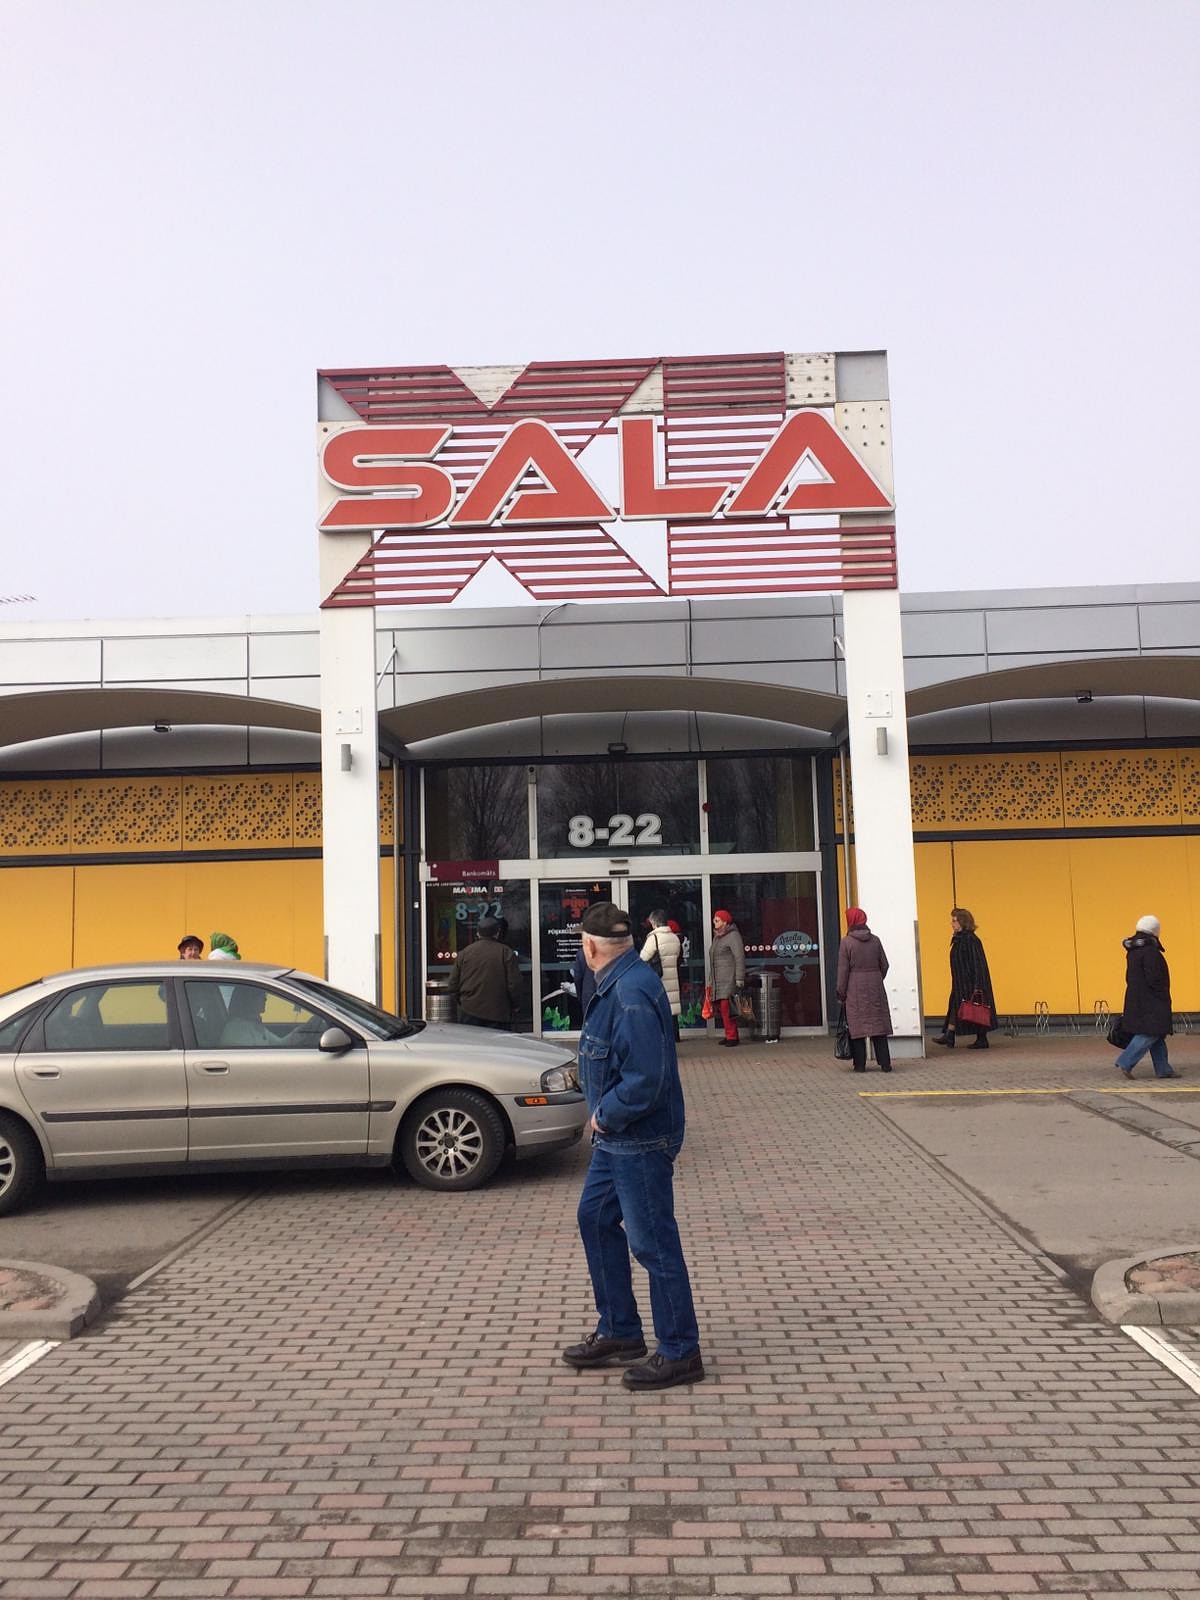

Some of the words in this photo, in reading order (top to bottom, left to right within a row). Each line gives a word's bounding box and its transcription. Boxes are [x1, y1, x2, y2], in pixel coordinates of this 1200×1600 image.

[318, 410, 895, 531] SALA
[568, 815, 663, 847] 8-22
[453, 886, 488, 895] MAXIMA
